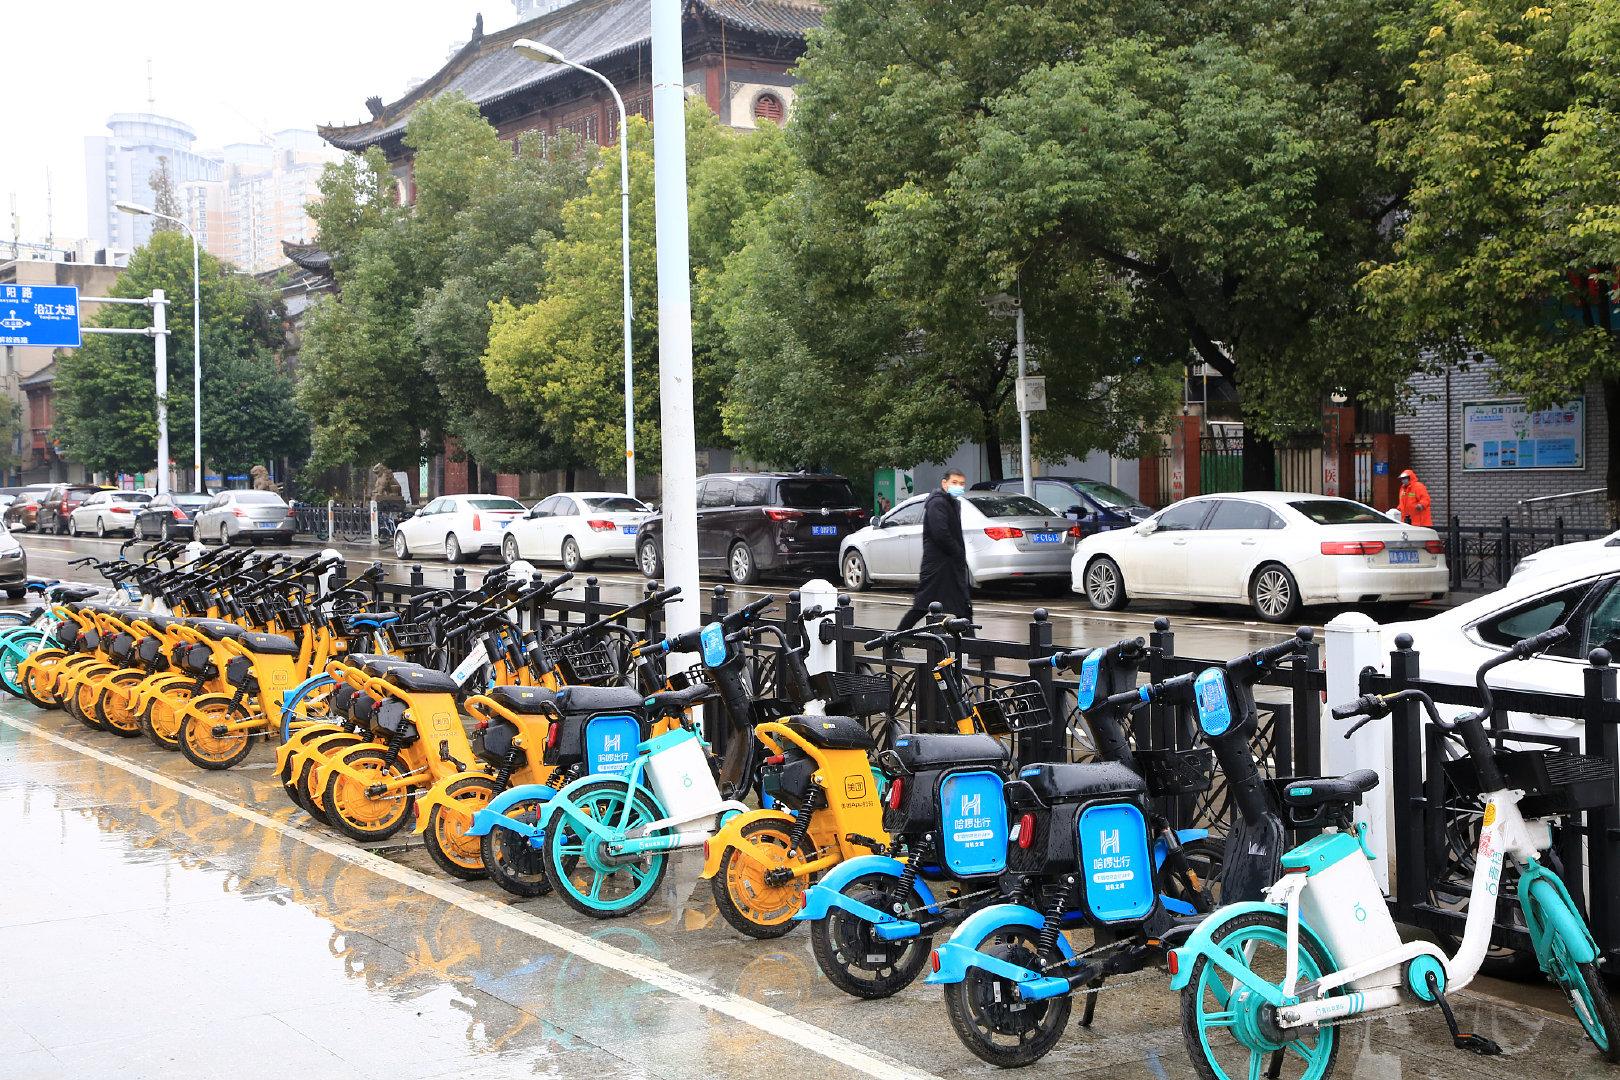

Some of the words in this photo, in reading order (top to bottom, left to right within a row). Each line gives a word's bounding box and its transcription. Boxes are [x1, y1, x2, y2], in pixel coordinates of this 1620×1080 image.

[0, 286, 33, 298] 阳路
[33, 303, 76, 315] 沿江大道
[847, 781, 863, 792] 美团
[954, 817, 992, 830] 哈啰出行
[1093, 855, 1131, 870] 哈啰出行
